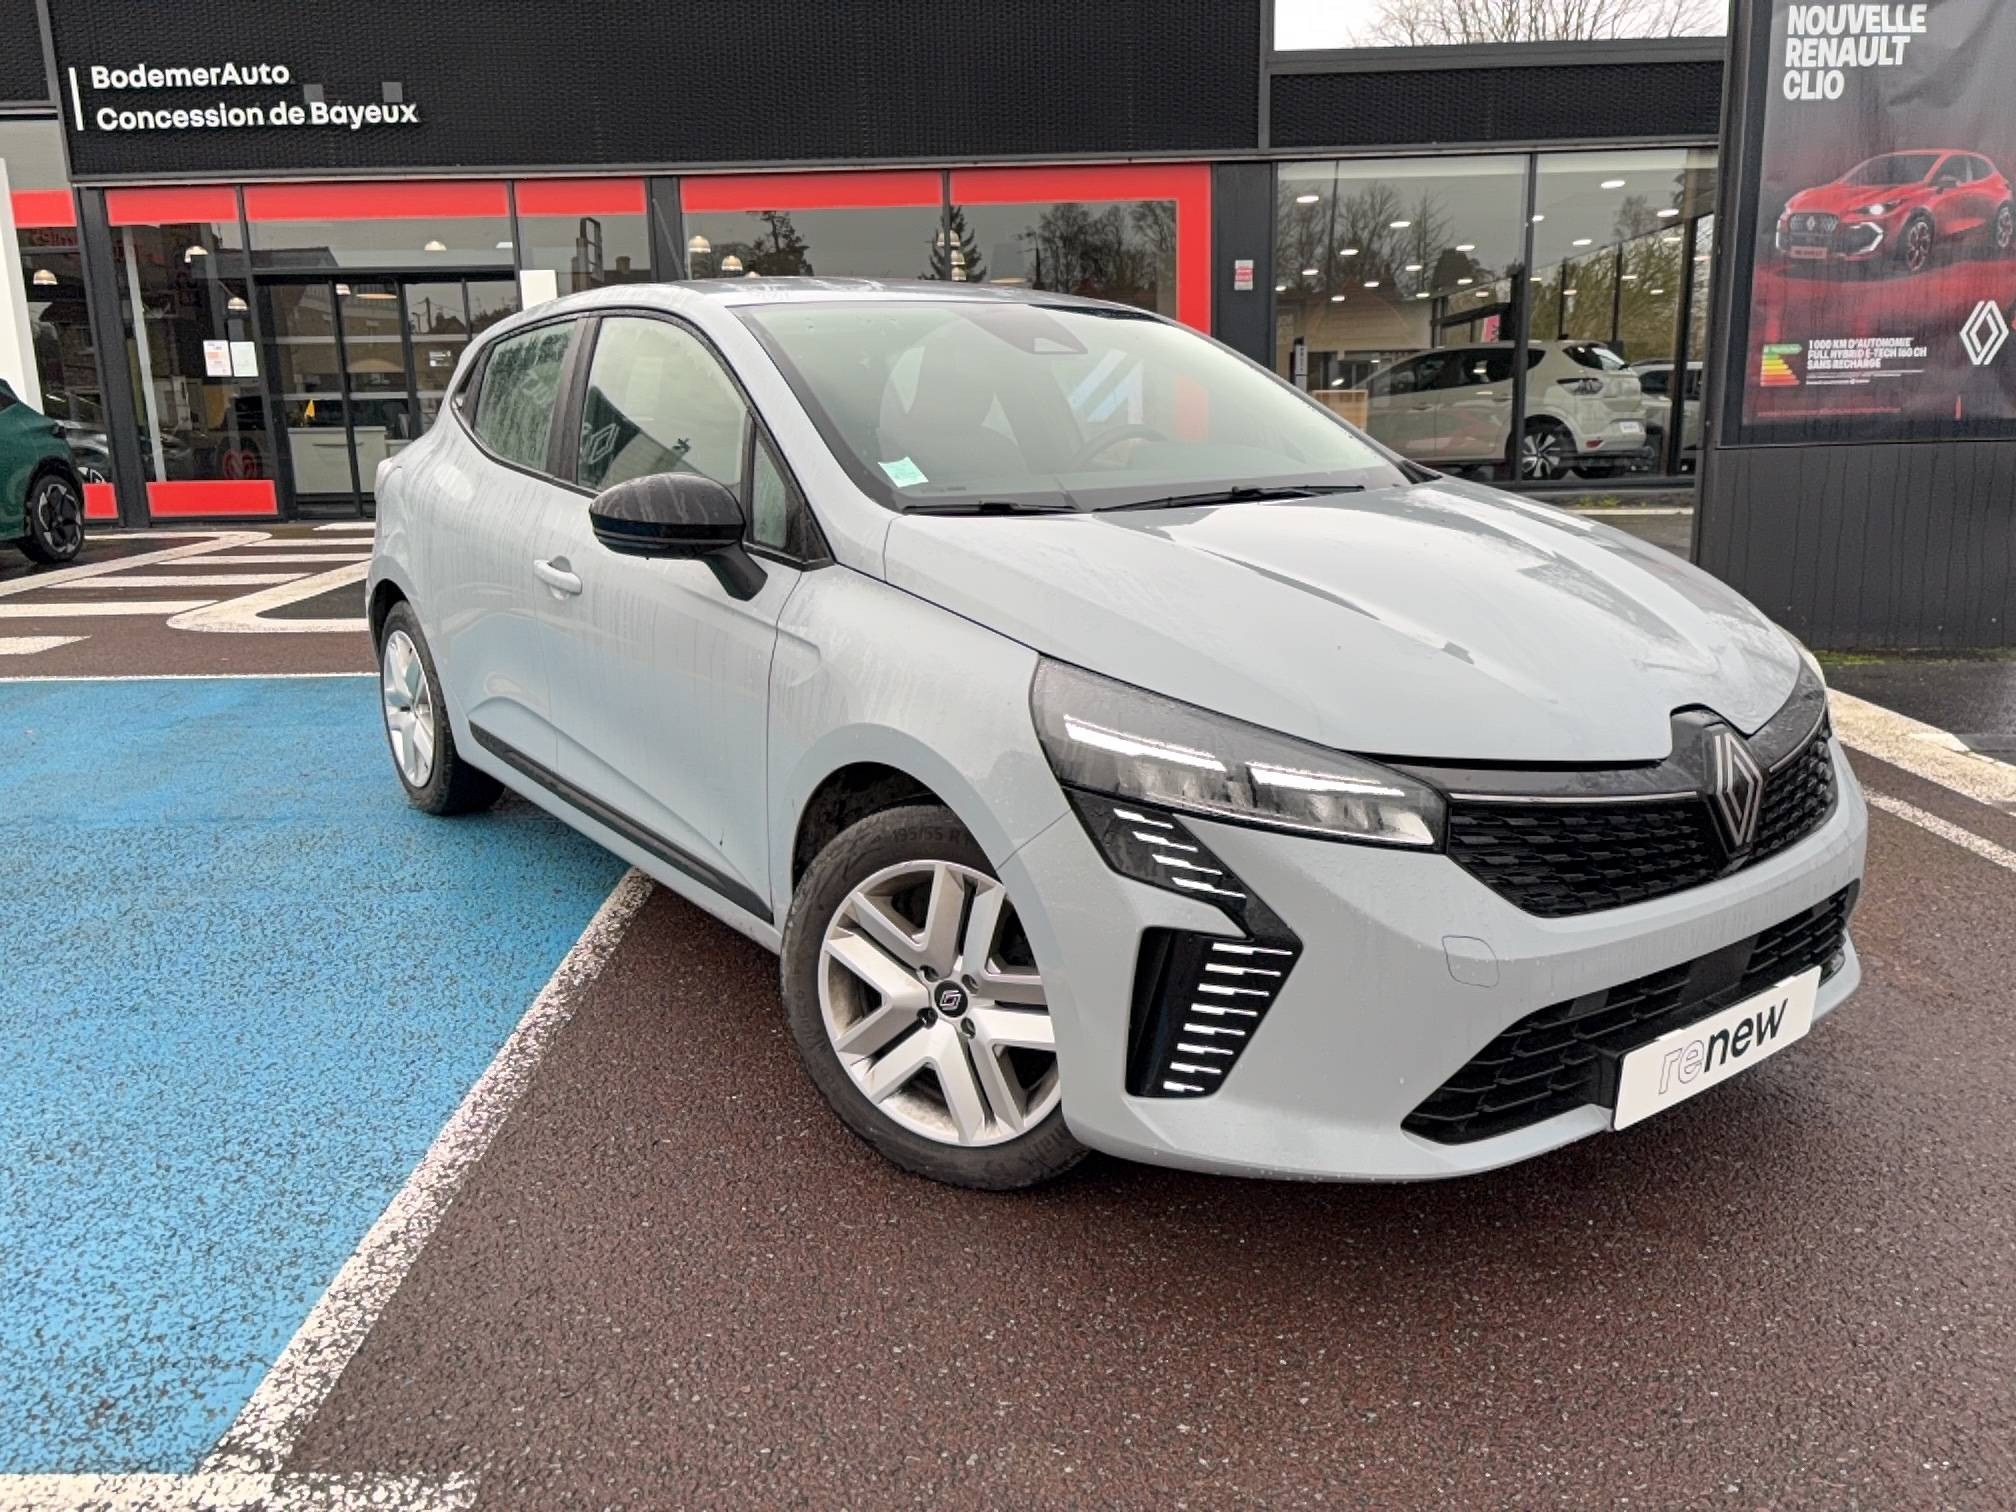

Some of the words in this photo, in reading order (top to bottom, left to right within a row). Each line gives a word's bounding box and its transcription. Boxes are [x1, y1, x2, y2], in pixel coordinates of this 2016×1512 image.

[1787, 3, 1928, 35] NOUVELLE
[1784, 35, 1911, 68] RENAULT
[91, 62, 290, 90] BodemerAuto
[1783, 69, 1845, 101] CLIO
[96, 101, 265, 131] Concession
[269, 101, 305, 125] de
[309, 101, 419, 130] Bayeux
[1807, 350, 1829, 360] FULL
[1865, 347, 1898, 358] E-TECH
[1913, 346, 1928, 358] CH
[1833, 339, 1847, 349] KM
[1806, 359, 1831, 370] SANS
[1831, 358, 1881, 370] RECHARGE
[1658, 997, 1789, 1095] renew
